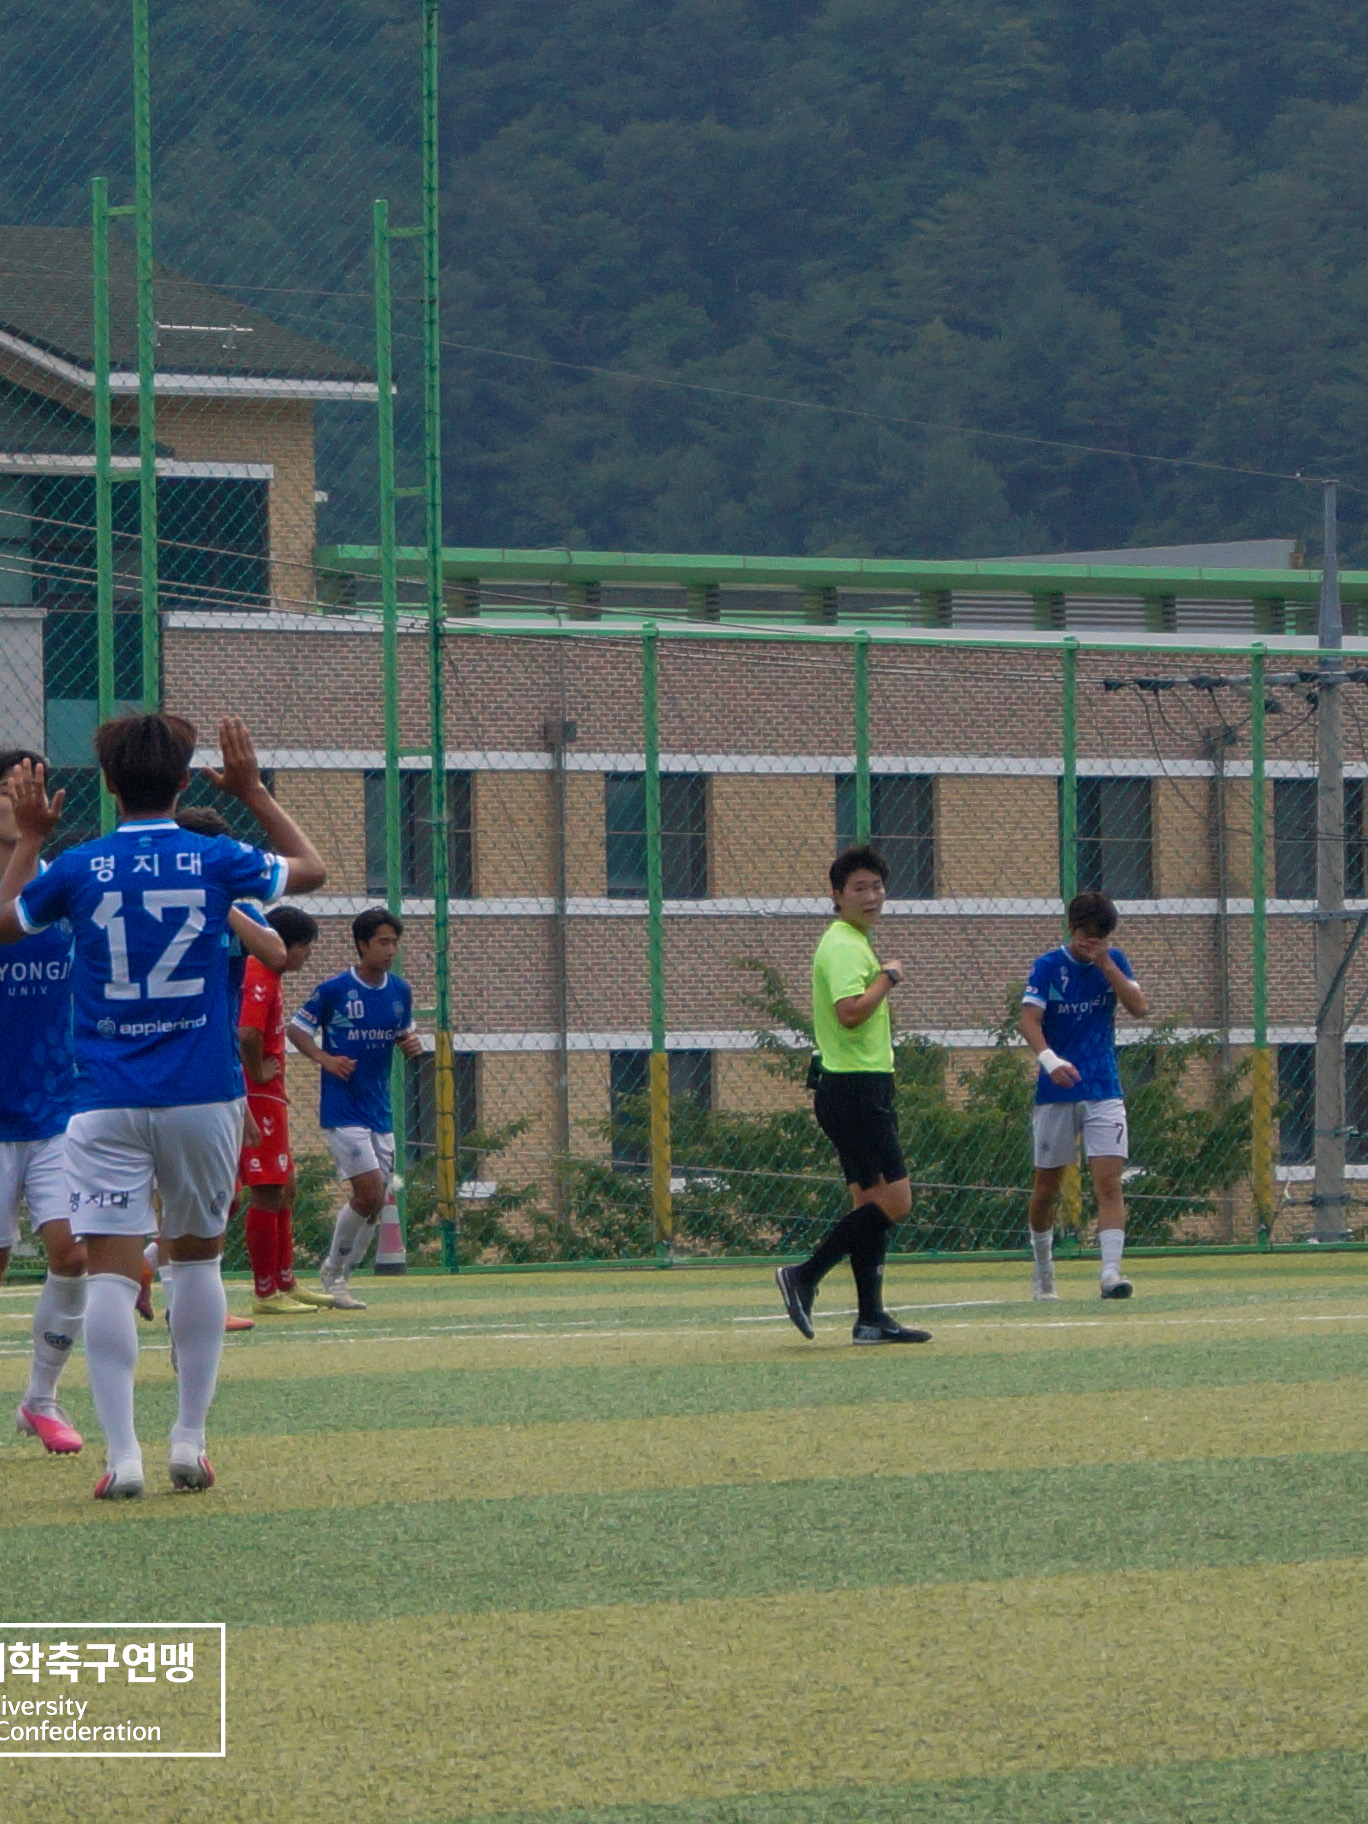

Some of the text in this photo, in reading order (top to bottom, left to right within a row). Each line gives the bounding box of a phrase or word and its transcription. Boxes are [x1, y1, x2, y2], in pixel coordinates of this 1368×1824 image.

[91, 888, 207, 1001] 12
[8, 985, 48, 996] UNIV
[1060, 975, 1070, 994] 7
[345, 1000, 365, 1019] 10
[119, 1013, 207, 1037] applerind
[1114, 1122, 1125, 1145] 7
